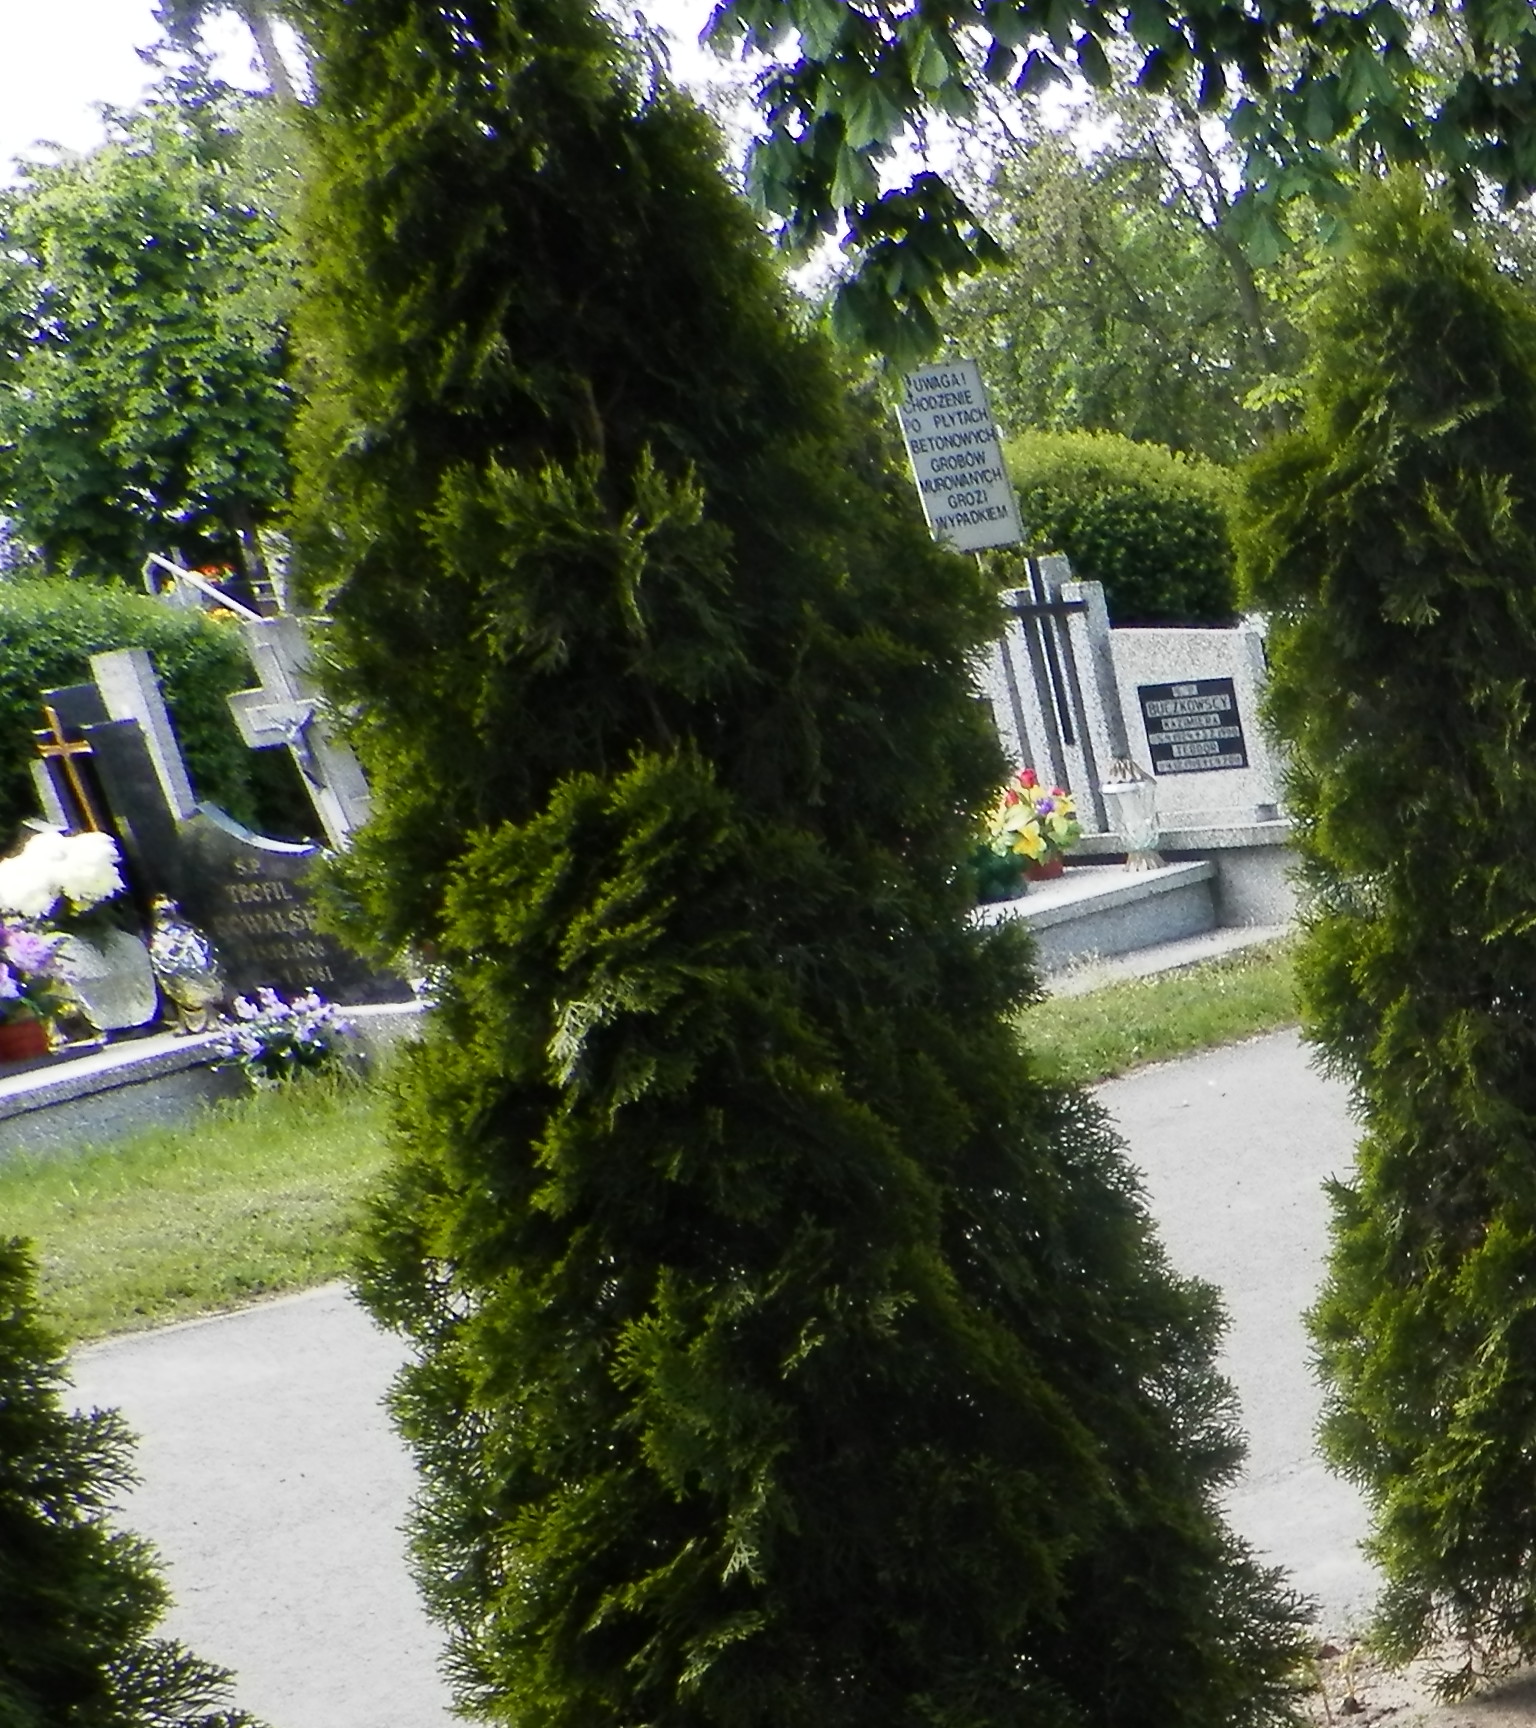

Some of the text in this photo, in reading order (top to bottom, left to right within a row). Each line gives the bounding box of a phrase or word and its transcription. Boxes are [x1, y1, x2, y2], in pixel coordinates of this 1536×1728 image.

[905, 418, 921, 434] PO
[911, 427, 997, 454] BETONOWYCH
[931, 451, 986, 472] GROBÓW
[920, 468, 1003, 493] MUROWANYCH
[948, 490, 988, 509] GROZI
[936, 505, 1009, 531] WYPADKIEM
